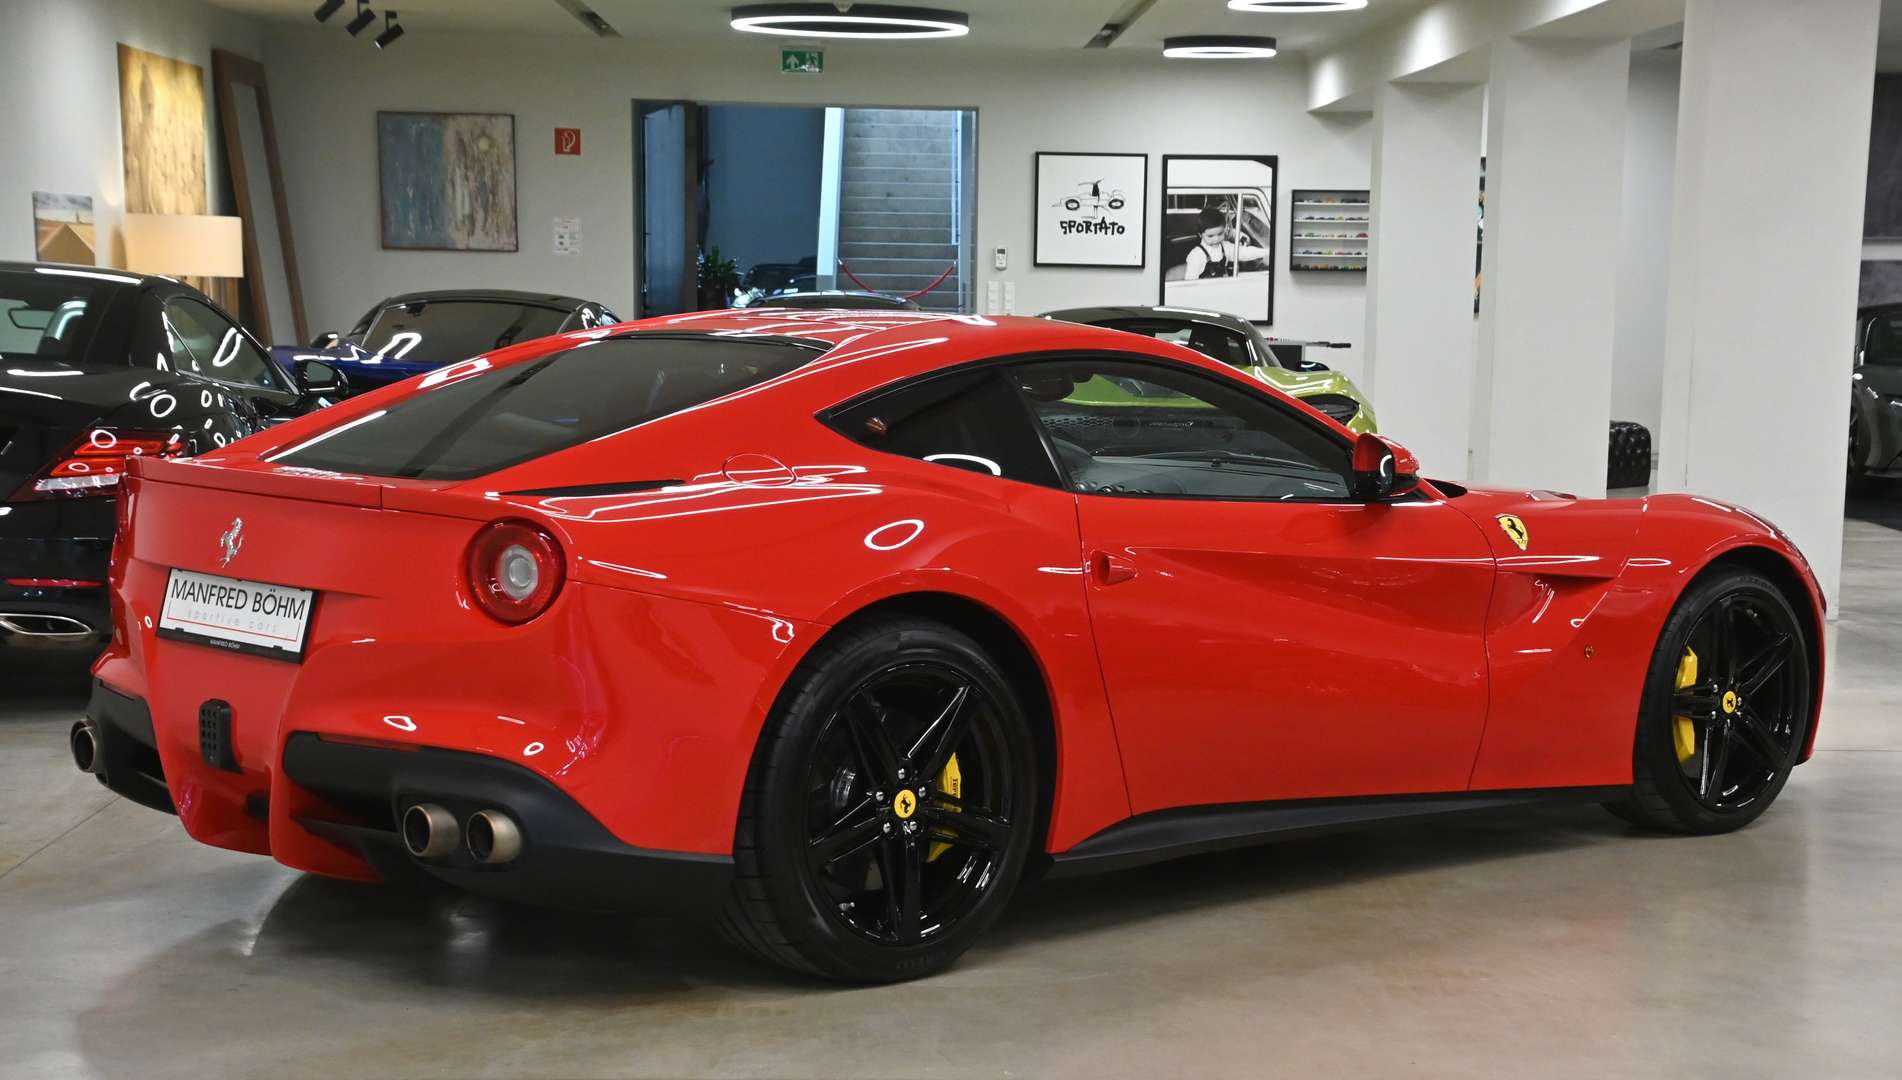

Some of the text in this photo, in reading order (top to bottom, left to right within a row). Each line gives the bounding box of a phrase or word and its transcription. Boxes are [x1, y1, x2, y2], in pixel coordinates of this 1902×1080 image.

[1059, 216, 1126, 236] SPORTATO
[171, 578, 305, 620] MANFRED BÖHM
